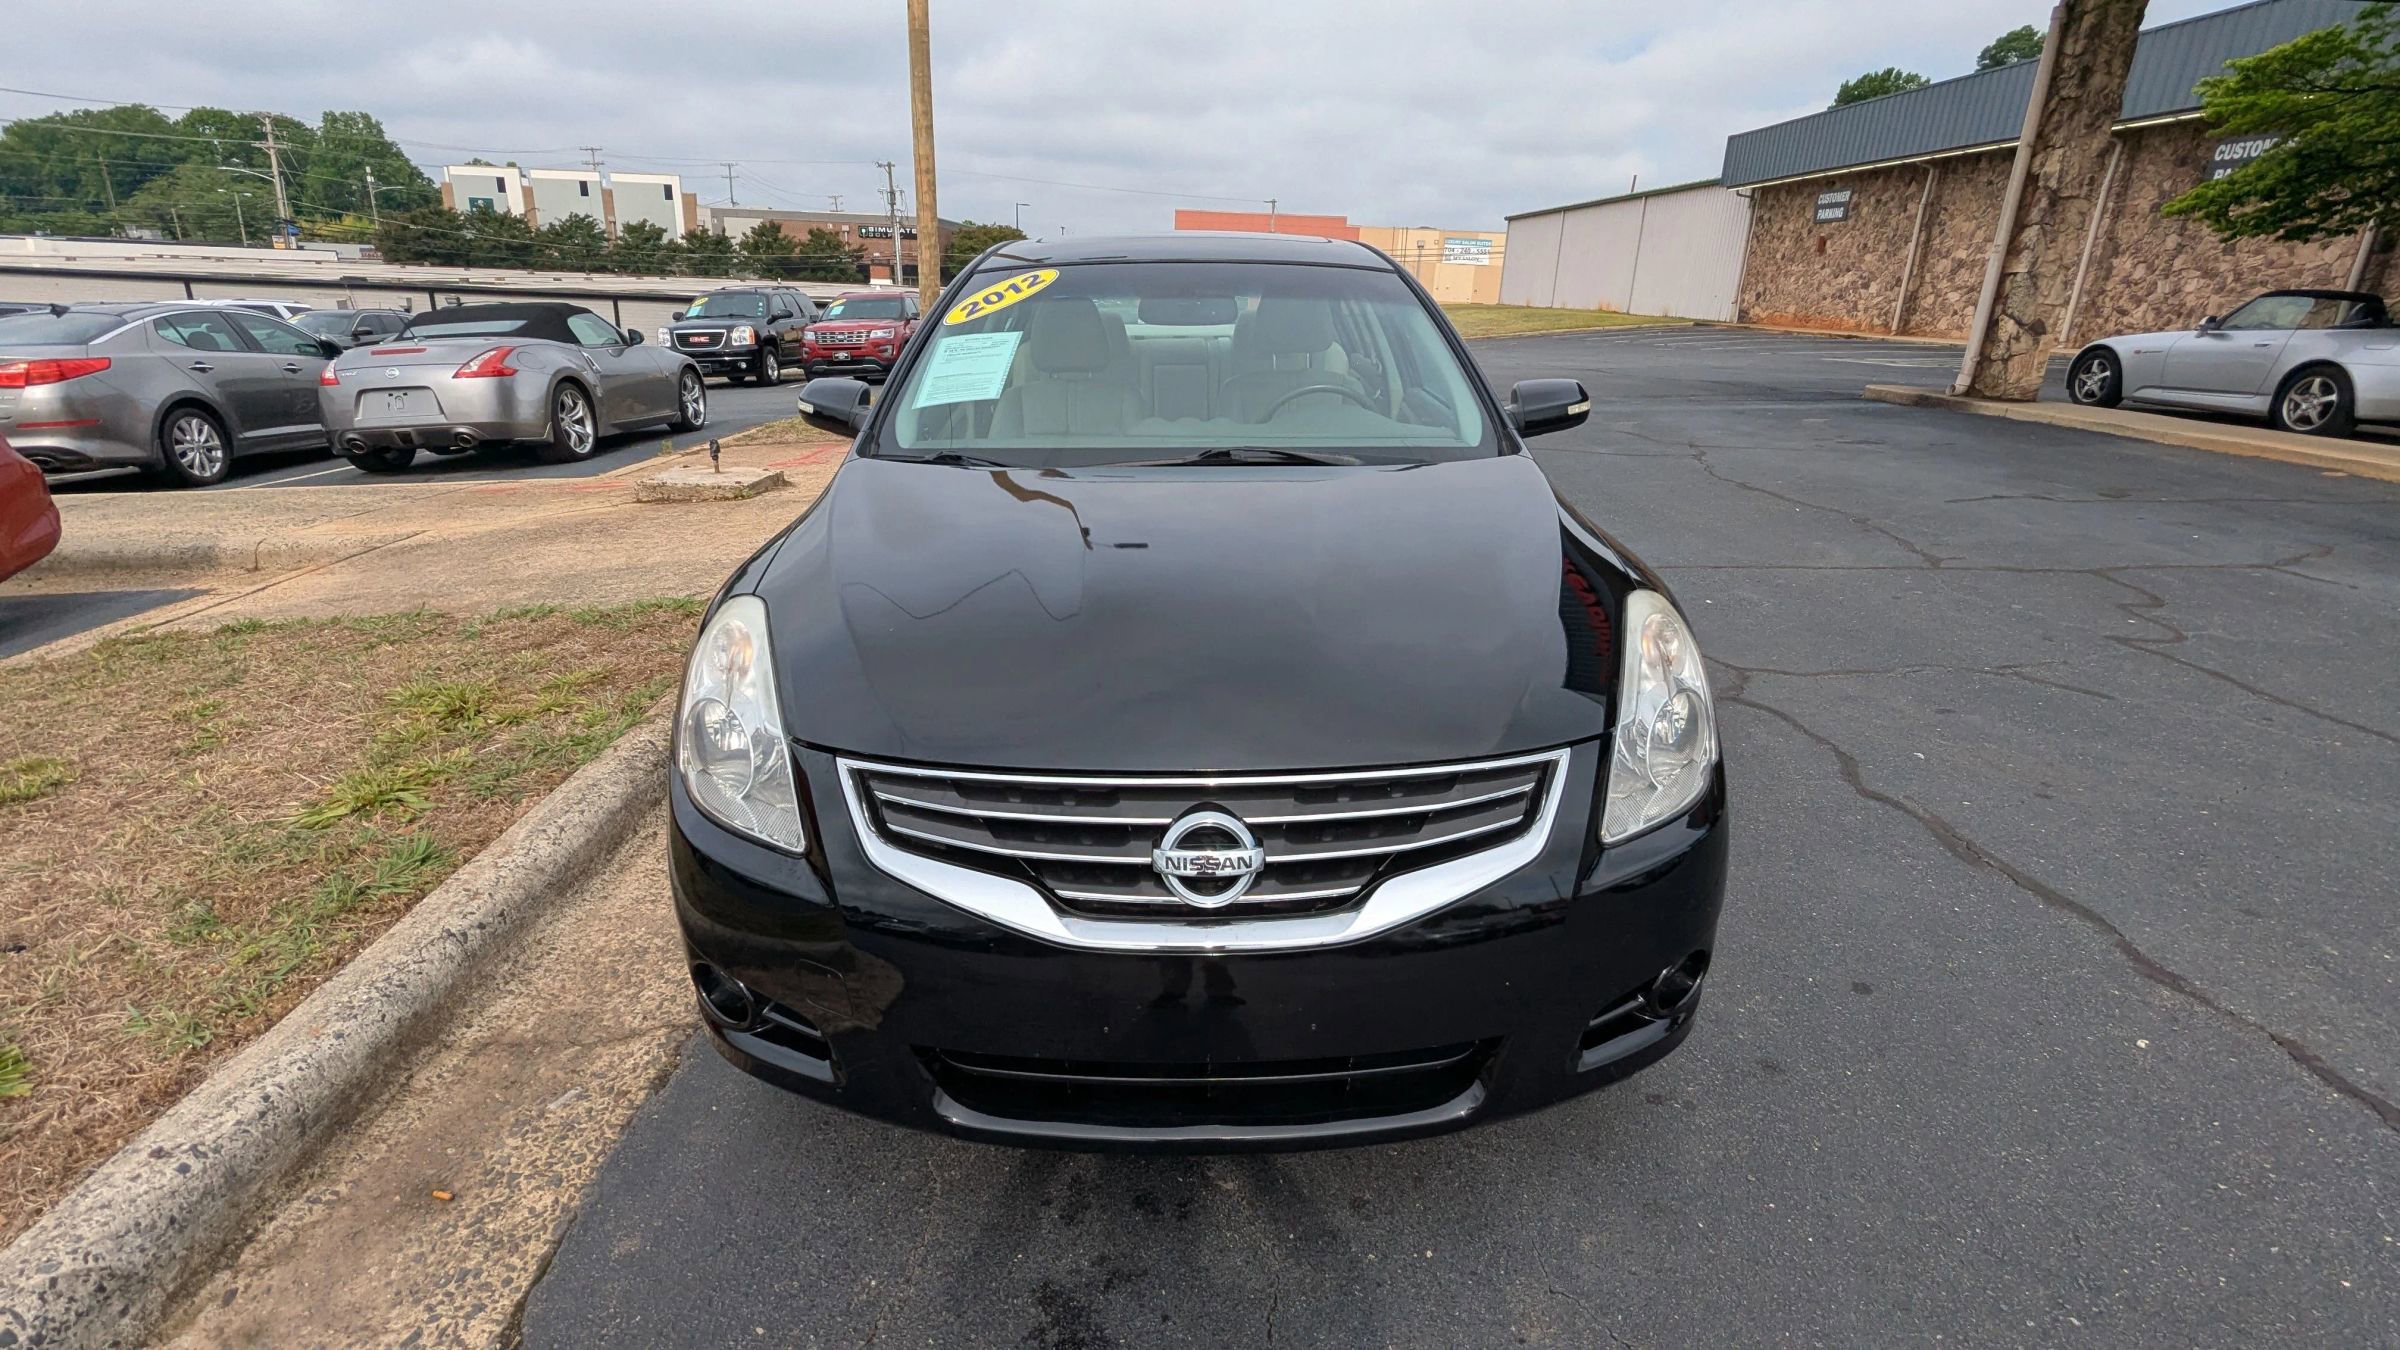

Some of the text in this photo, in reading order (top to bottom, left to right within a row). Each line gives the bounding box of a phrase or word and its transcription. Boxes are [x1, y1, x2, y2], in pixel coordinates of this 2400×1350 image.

[2214, 138, 2299, 161] CUSTOM
[1817, 190, 1851, 205] CUSTOMER
[1816, 206, 1844, 220] PARKING
[868, 226, 917, 234] SIMUATE
[960, 274, 1047, 319] 2012
[1164, 855, 1253, 872] NISSAN
